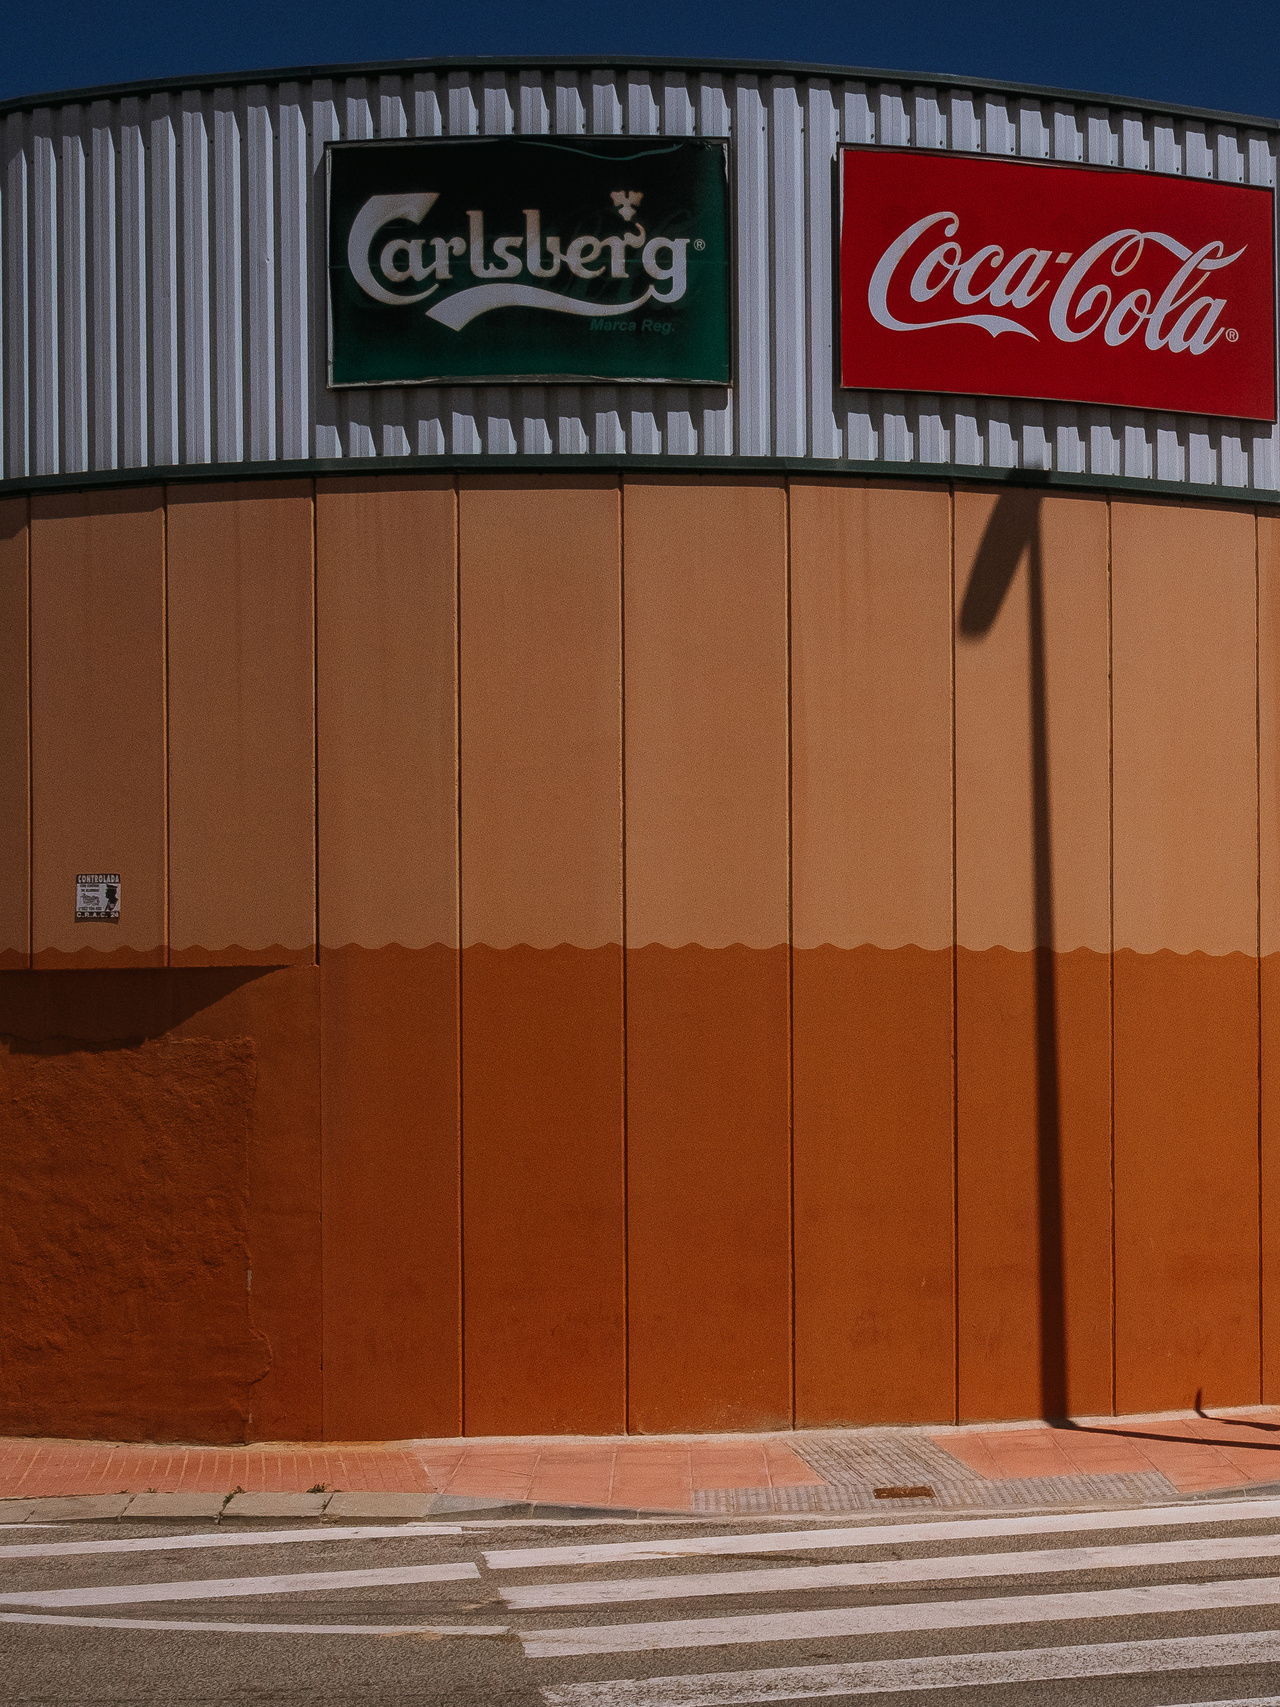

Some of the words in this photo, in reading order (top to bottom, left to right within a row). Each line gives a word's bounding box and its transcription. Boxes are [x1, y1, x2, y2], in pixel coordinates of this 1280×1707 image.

[347, 191, 691, 304] Carlsberg
[867, 210, 1248, 356] Coca-Cola
[589, 318, 637, 331] Marca
[641, 318, 675, 336] Reg.
[78, 874, 120, 883] CONTROLADA
